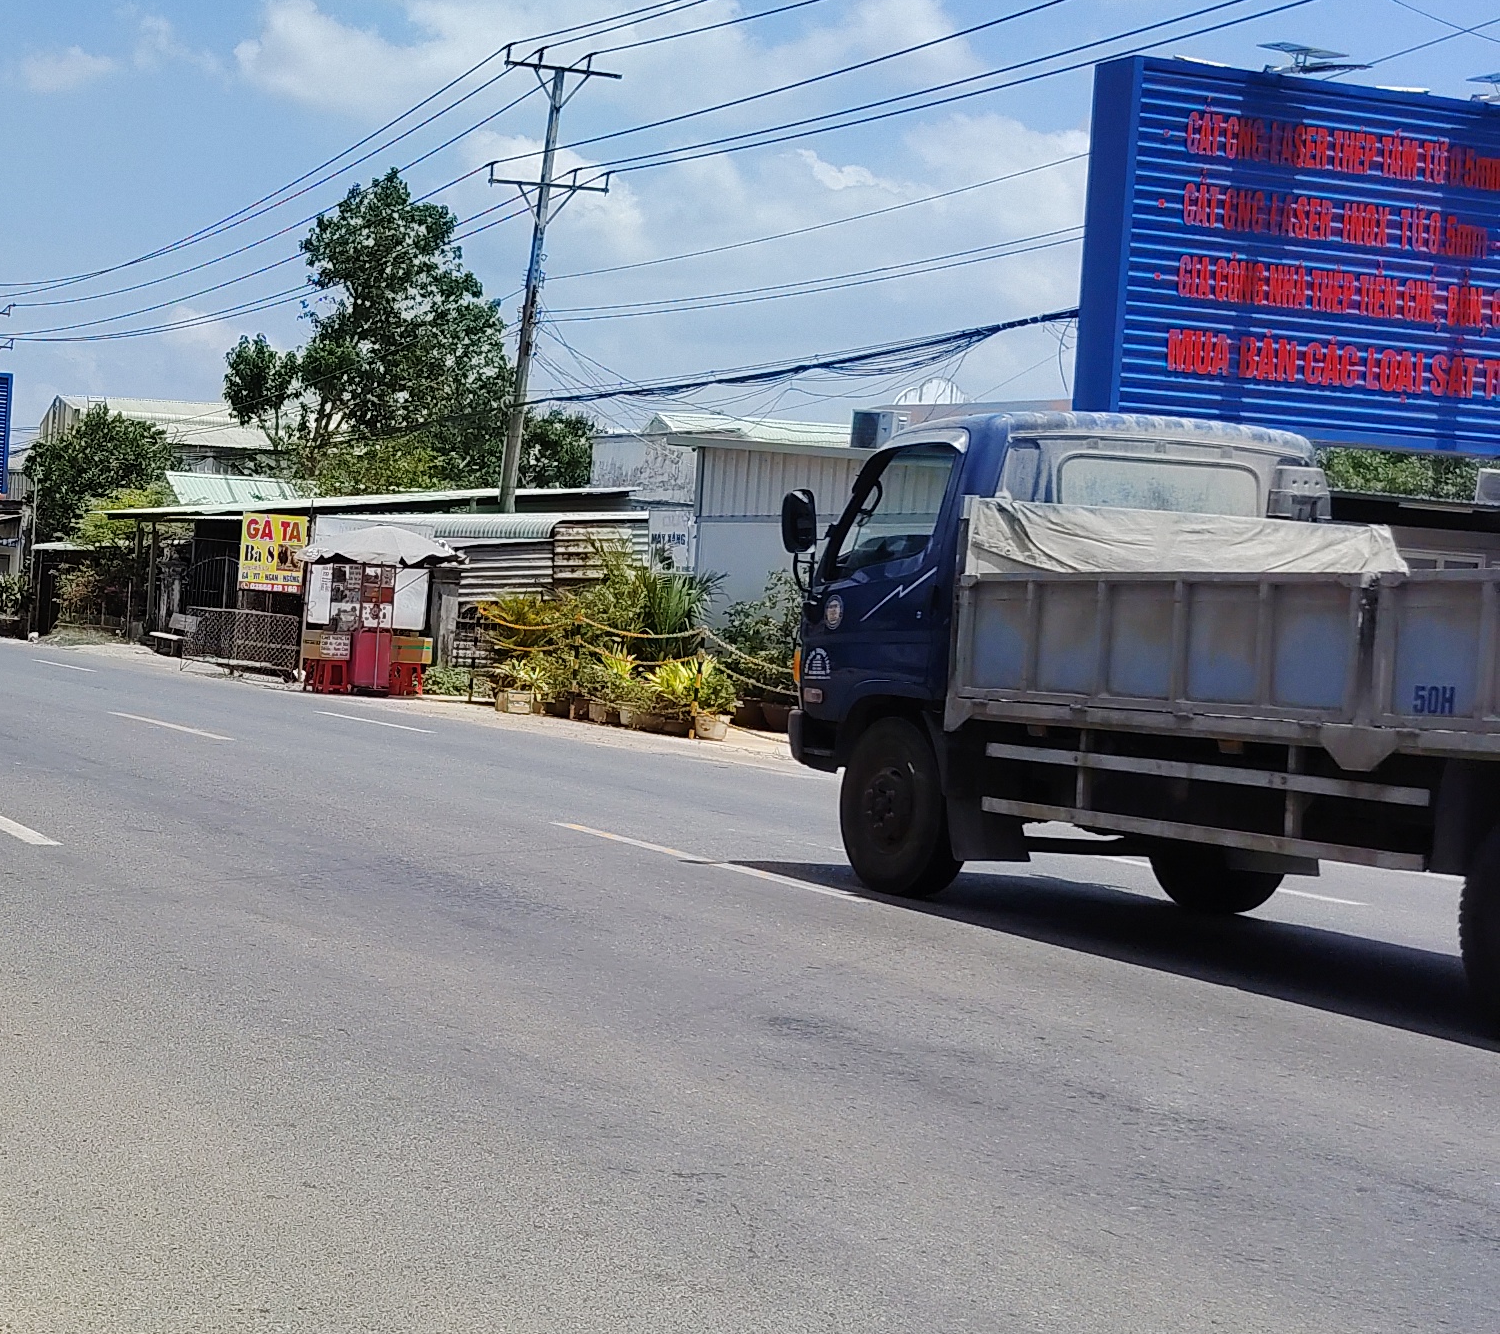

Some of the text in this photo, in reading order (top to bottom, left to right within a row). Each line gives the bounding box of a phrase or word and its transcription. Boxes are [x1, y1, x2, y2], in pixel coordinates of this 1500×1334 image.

[1269, 121, 1329, 171] LASER
[1333, 125, 1377, 175] THÉP
[1223, 188, 1265, 233] CNC
[1269, 193, 1333, 243] LASER
[1342, 203, 1391, 248] INOX
[1178, 255, 1211, 299] GIA
[1215, 251, 1265, 305] CÔNG
[1167, 329, 1230, 376] MUA
[1238, 329, 1298, 382] BÁN
[1304, 335, 1359, 388] CÁC
[1366, 348, 1425, 404] LOẠI
[244, 544, 262, 562] Bà
[246, 515, 302, 543] GÀ TA
[1412, 685, 1456, 715] 50H
